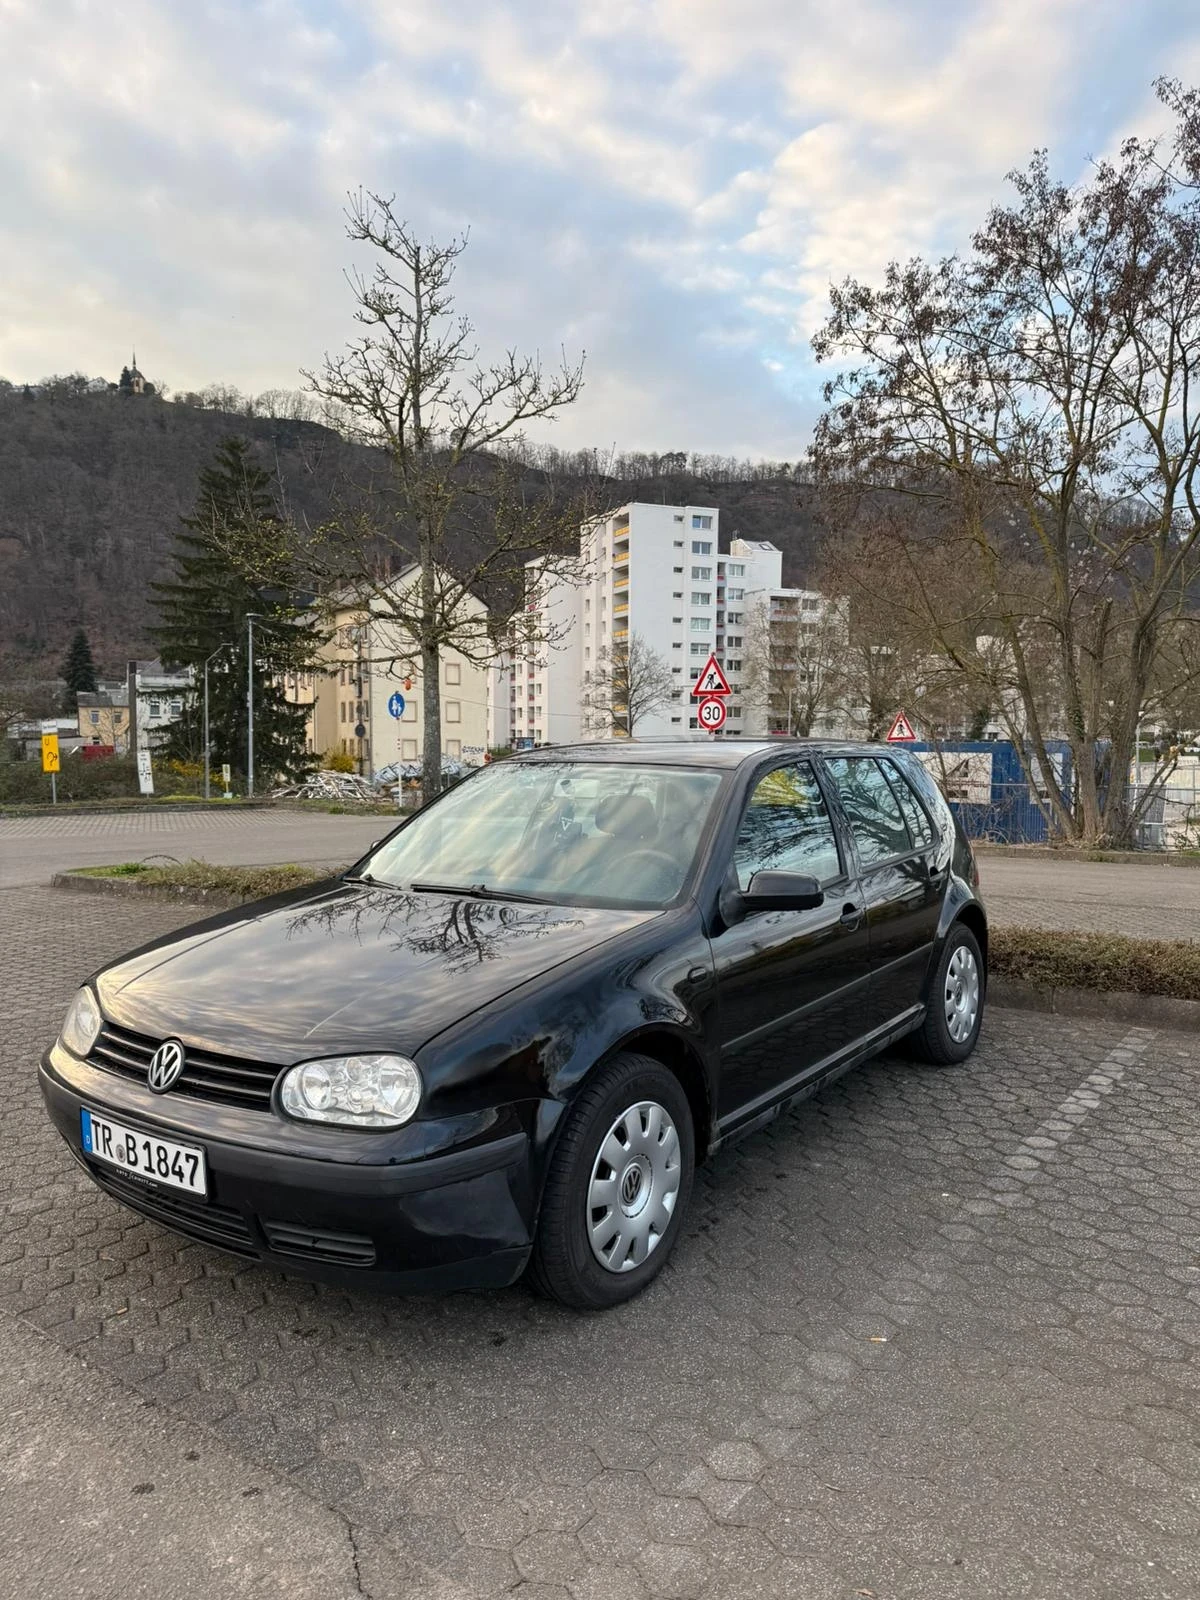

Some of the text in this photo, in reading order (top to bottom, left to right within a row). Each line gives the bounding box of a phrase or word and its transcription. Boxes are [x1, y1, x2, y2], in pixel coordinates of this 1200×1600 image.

[704, 706, 720, 721] 30
[44, 736, 50, 746] U
[91, 1119, 114, 1158] TR
